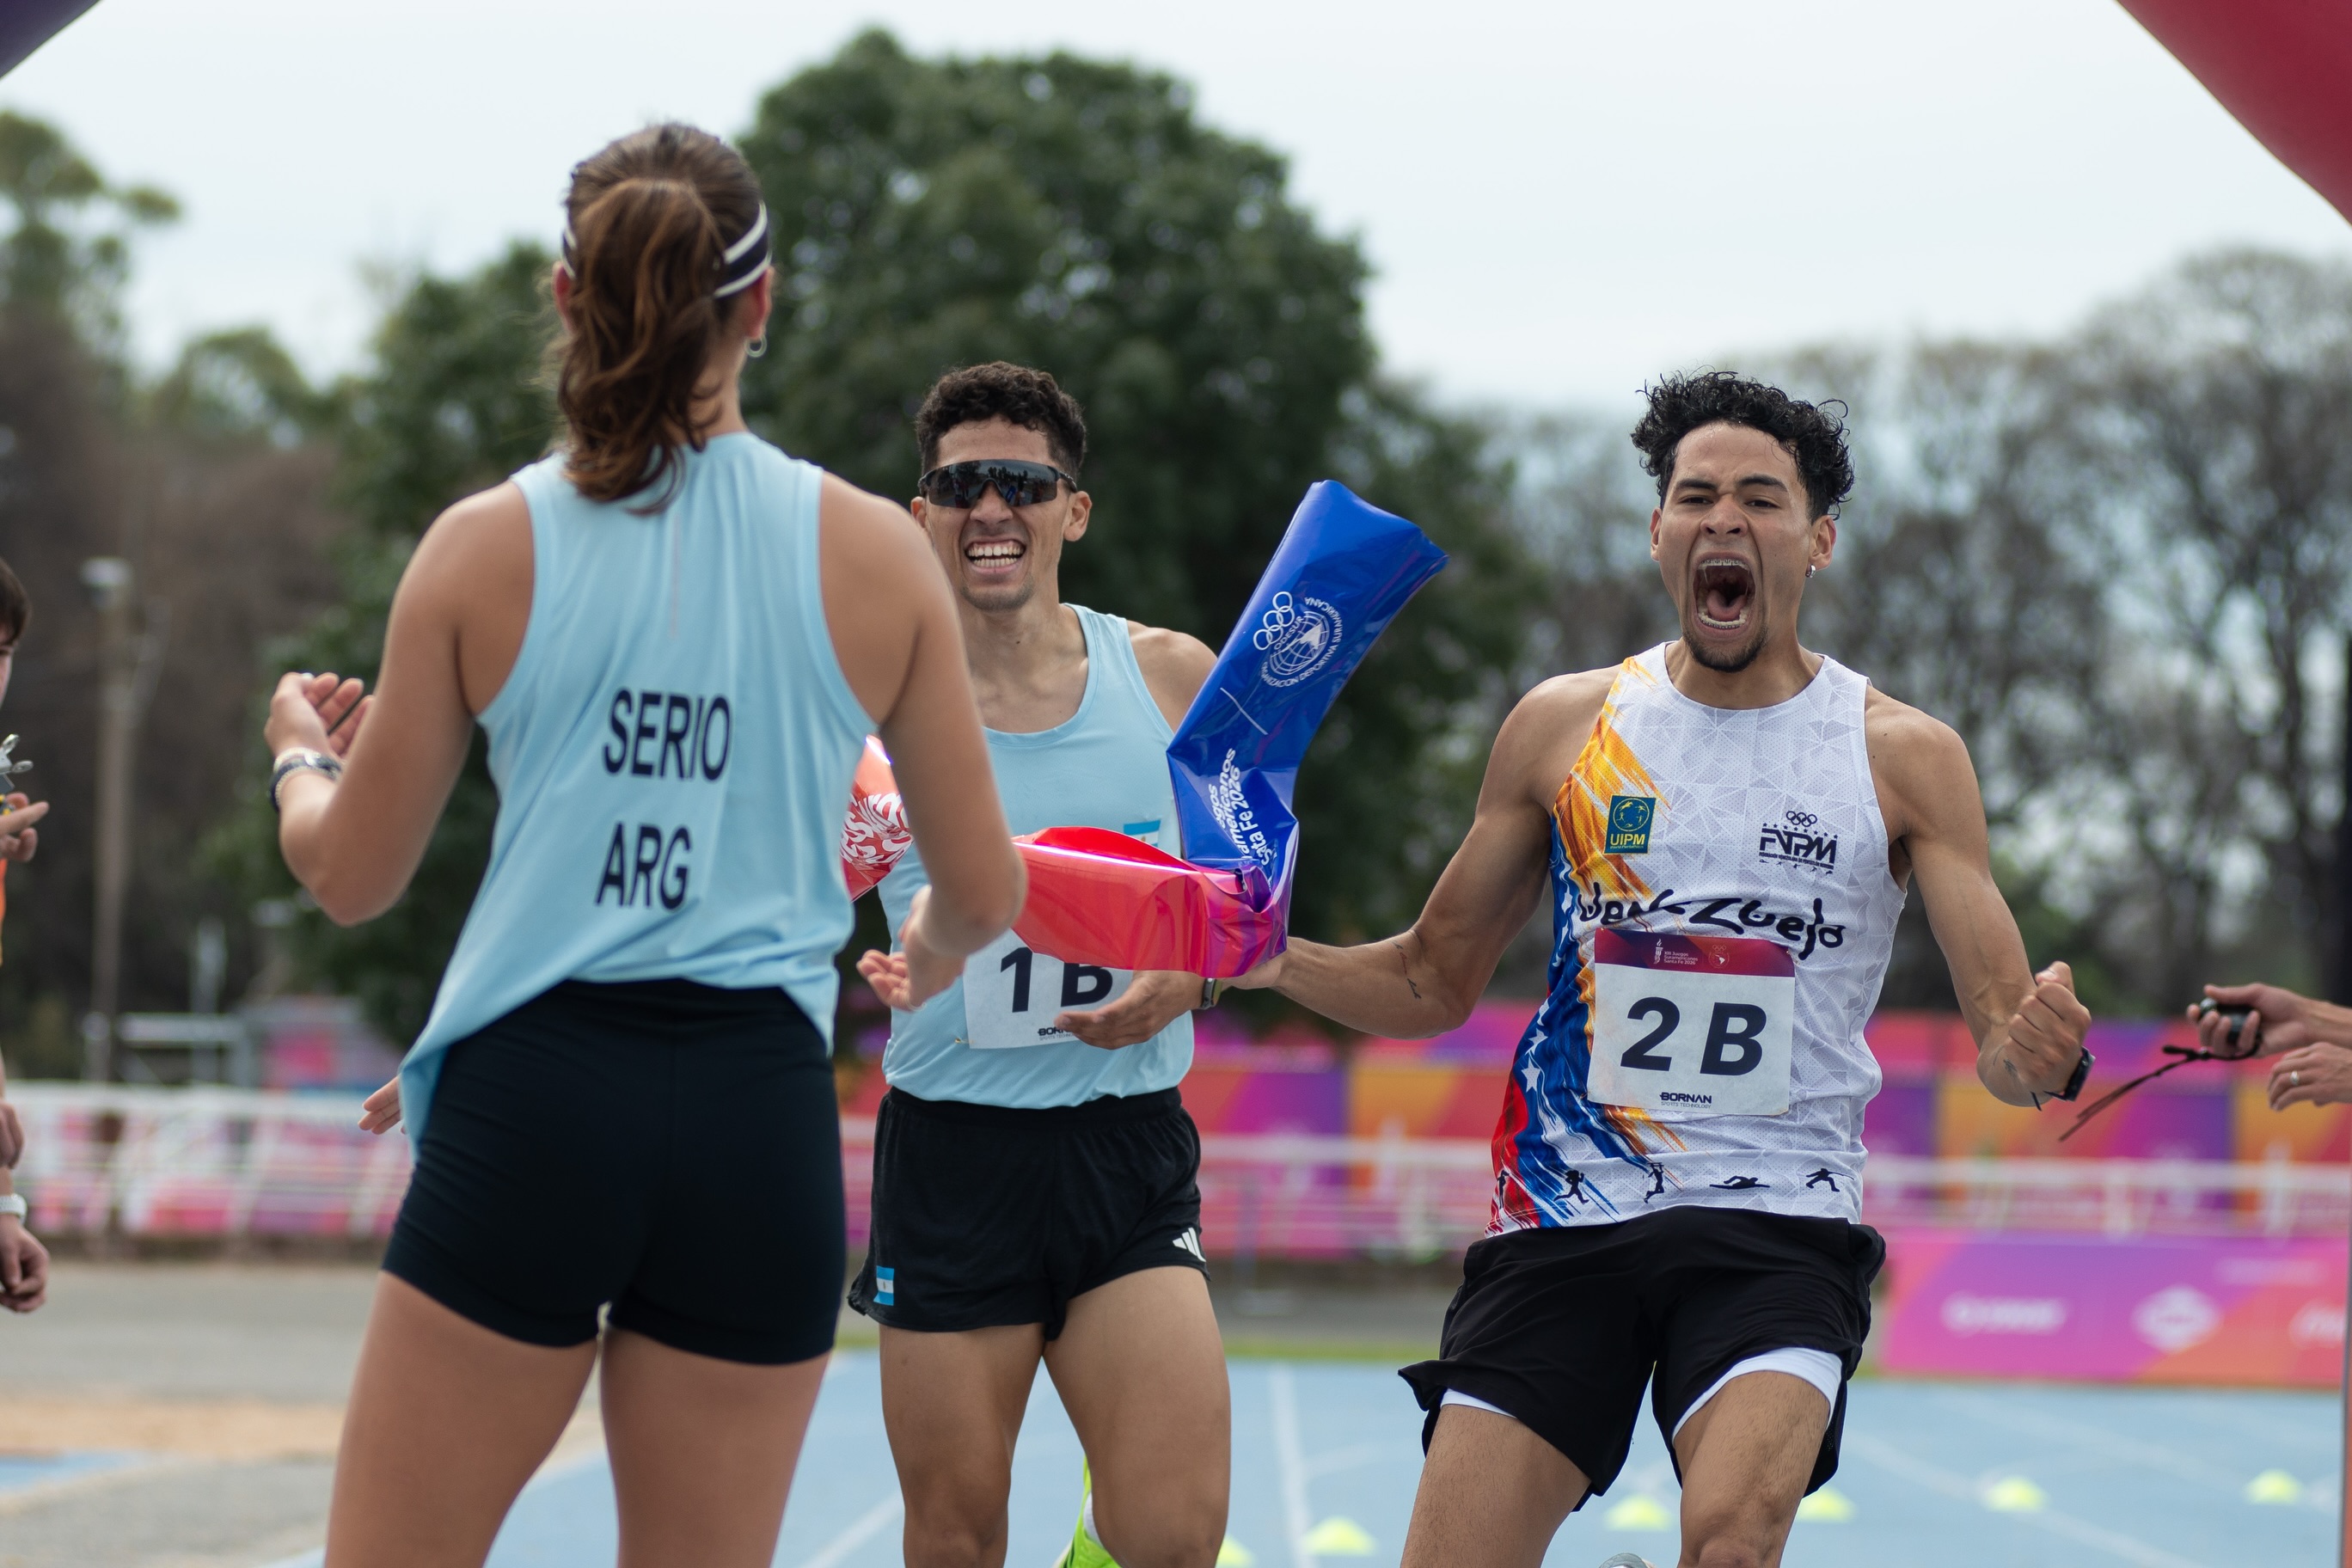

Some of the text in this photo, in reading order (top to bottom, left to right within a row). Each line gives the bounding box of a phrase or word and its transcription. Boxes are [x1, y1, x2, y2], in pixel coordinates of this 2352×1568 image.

[1274, 616, 1304, 650] ODESUR
[1304, 597, 1343, 643] SURAMERICANA
[1299, 645, 1338, 680] DEPORTIVA
[603, 689, 731, 781] SERIO
[1228, 764, 1249, 811] 2026
[1239, 811, 1259, 832] Fe
[1610, 834, 1645, 846] UIPM
[595, 823, 691, 910] ARG
[1760, 828, 1836, 864] FVPM
[1001, 946, 1113, 1013] 1 B
[1620, 996, 1767, 1076] 2 B
[1660, 1092, 1712, 1104] BORNAN
